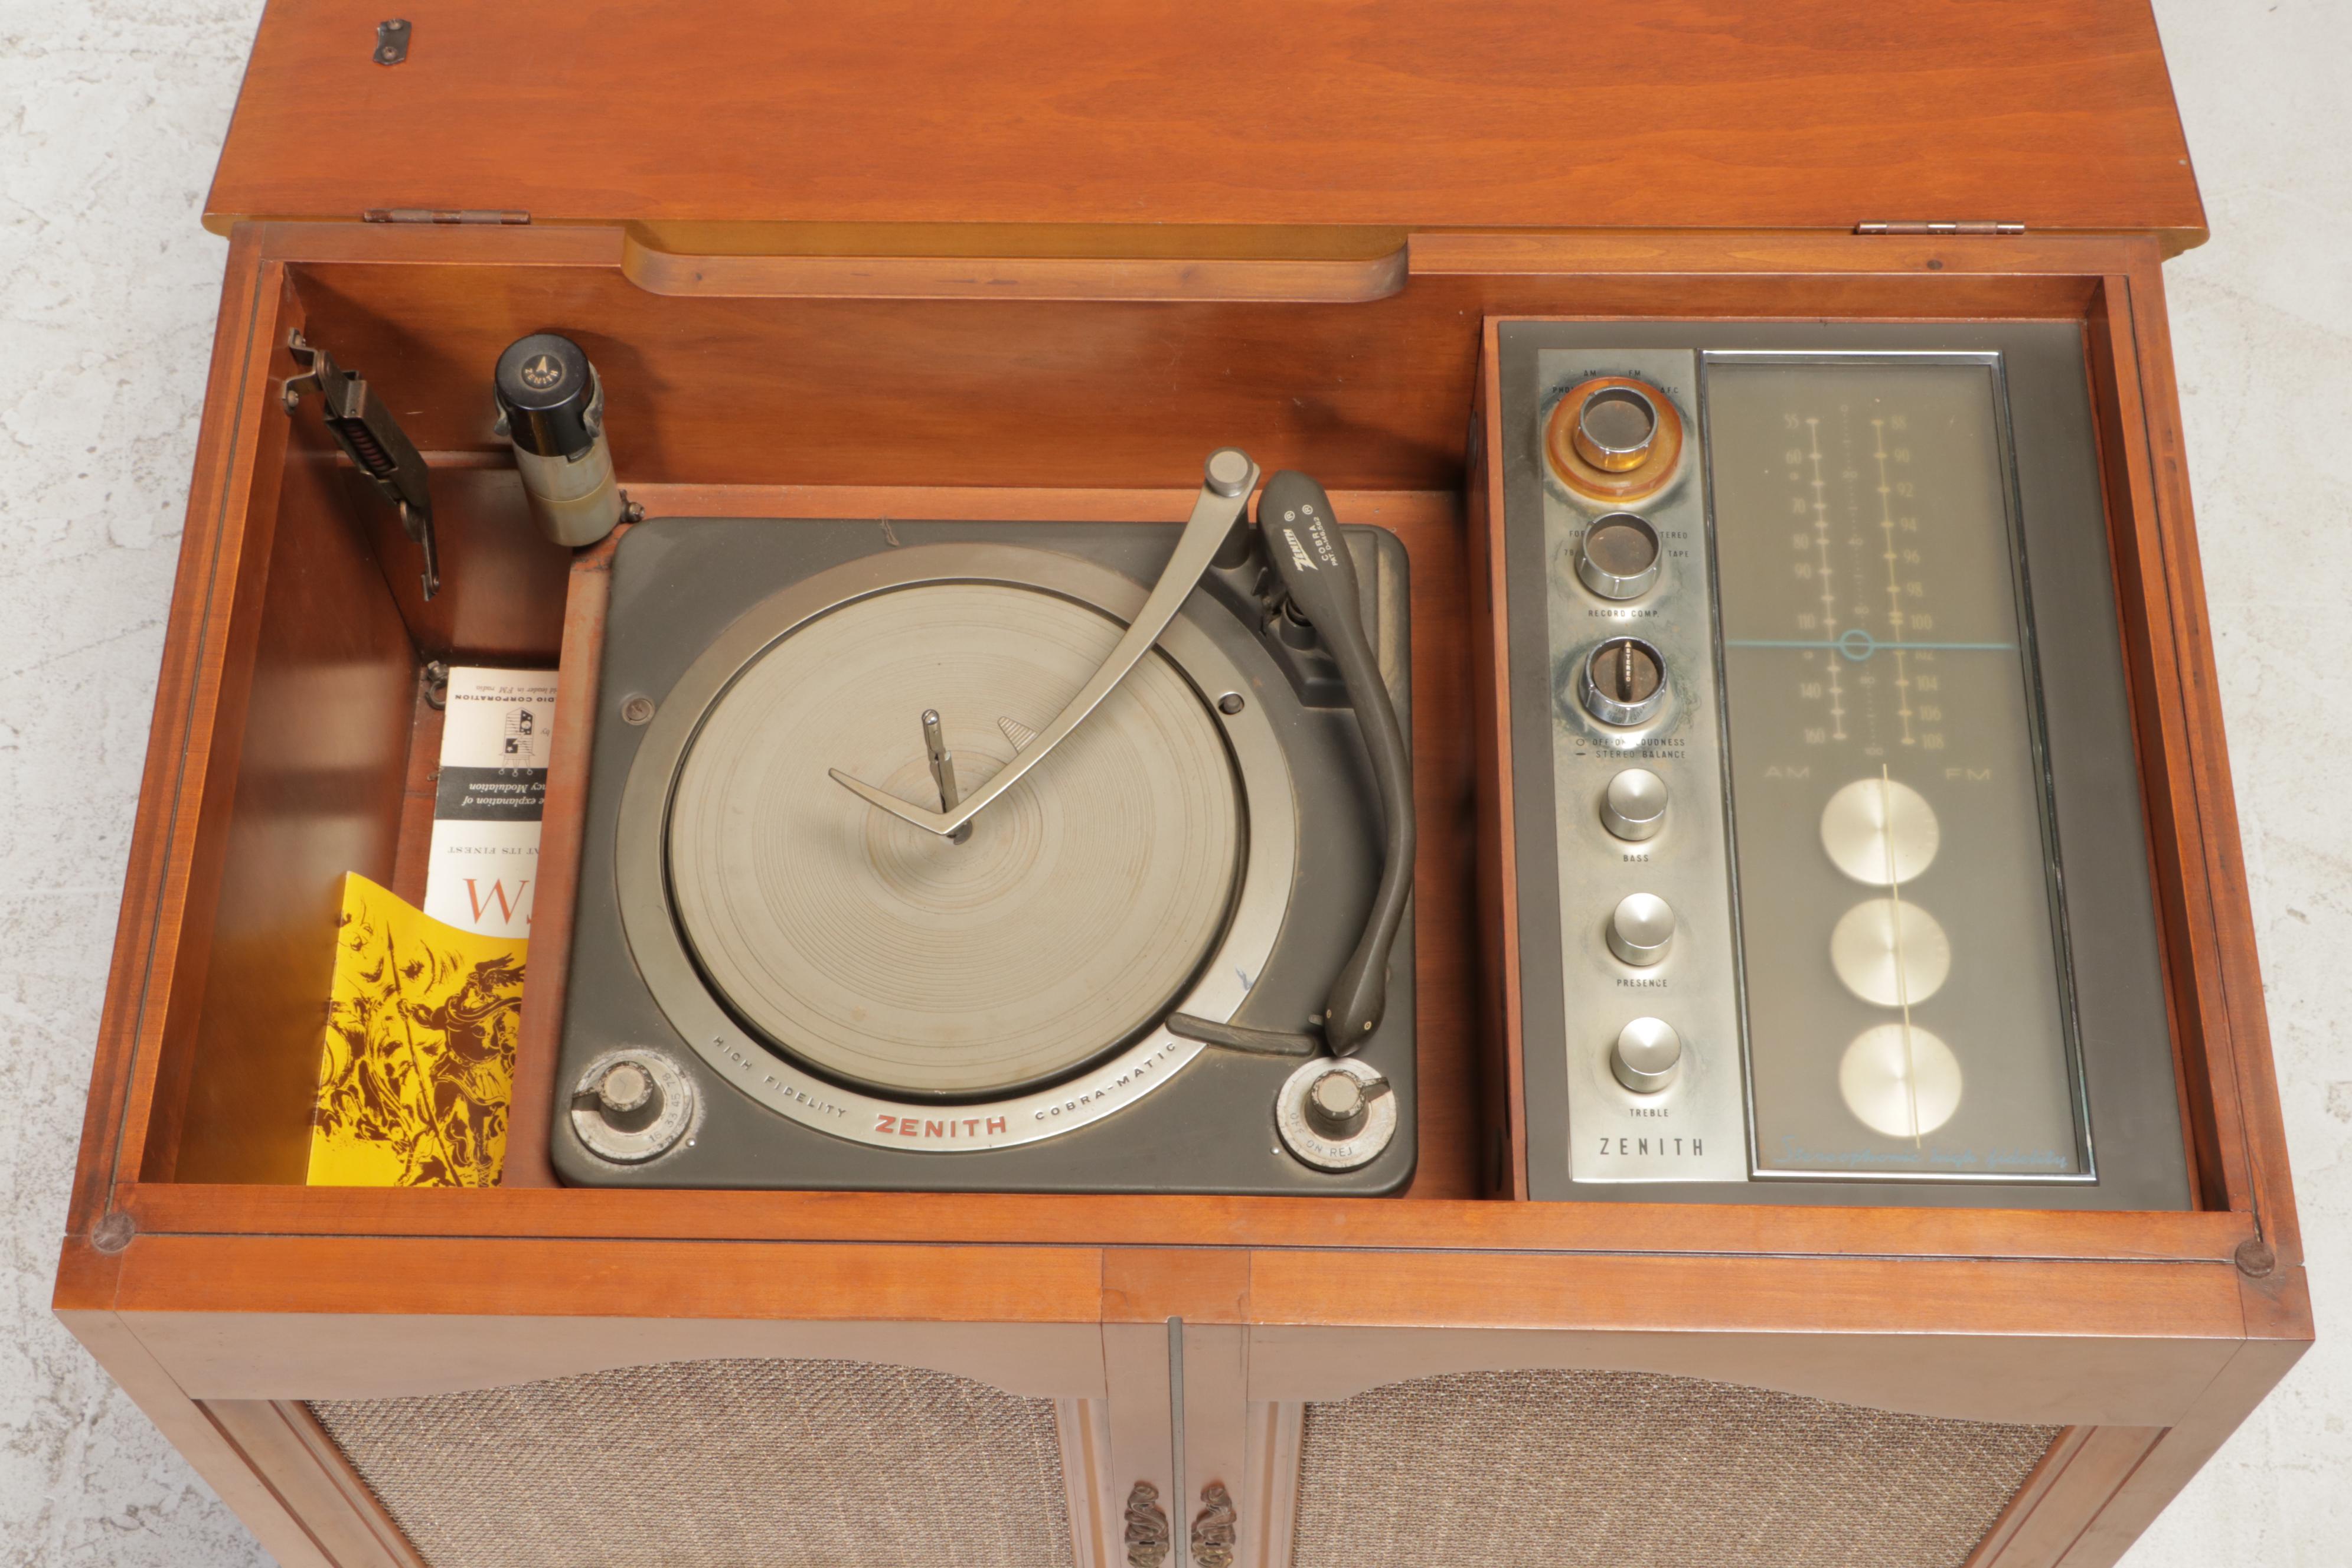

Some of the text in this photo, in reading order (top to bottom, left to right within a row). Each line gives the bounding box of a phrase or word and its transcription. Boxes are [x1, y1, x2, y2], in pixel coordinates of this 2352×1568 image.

[525, 368, 558, 384] ZENITH
[1785, 414, 1799, 429] 55
[1892, 415, 1908, 430] 88
[1786, 449, 1802, 465] 60
[1894, 448, 1910, 463] 90
[1897, 482, 1913, 498] 92
[1792, 498, 1806, 514] 70
[1900, 518, 1917, 533] 94
[1309, 525, 1328, 561] COBRA
[1794, 534, 1808, 550] 80
[1283, 529, 1318, 571] ZENITH
[1903, 548, 1920, 564] 96
[1795, 563, 1812, 579] 90
[1906, 582, 1923, 597] 98
[1798, 613, 1815, 629] 110
[1910, 614, 1932, 629] 100
[1800, 683, 1821, 698] 140
[1916, 675, 1938, 691] 104
[1920, 705, 1941, 721] 106
[541, 728, 550, 737] by
[1804, 728, 1825, 744] 160
[1923, 734, 1944, 750] 108
[1596, 750, 1686, 759] STEREO BALANCE
[1763, 766, 1810, 779] AM
[1945, 768, 1992, 780] FM
[469, 783, 528, 793] Modulation
[462, 796, 473, 806] of
[476, 796, 536, 807] explanation
[447, 846, 496, 854] FINEST
[1623, 854, 1649, 863] BASS
[1616, 979, 1667, 988] PRESENCE
[662, 1072, 676, 1087] 78
[713, 1035, 1176, 1138] HIGH FIDELITY ZENITH COBRA-MATIC
[671, 1093, 681, 1107] 45
[665, 1113, 678, 1128] 33
[1629, 1109, 1669, 1117] TREBLE
[1289, 1112, 1353, 1157] OFF ON REJ
[1599, 1138, 1703, 1156] ZENITH
